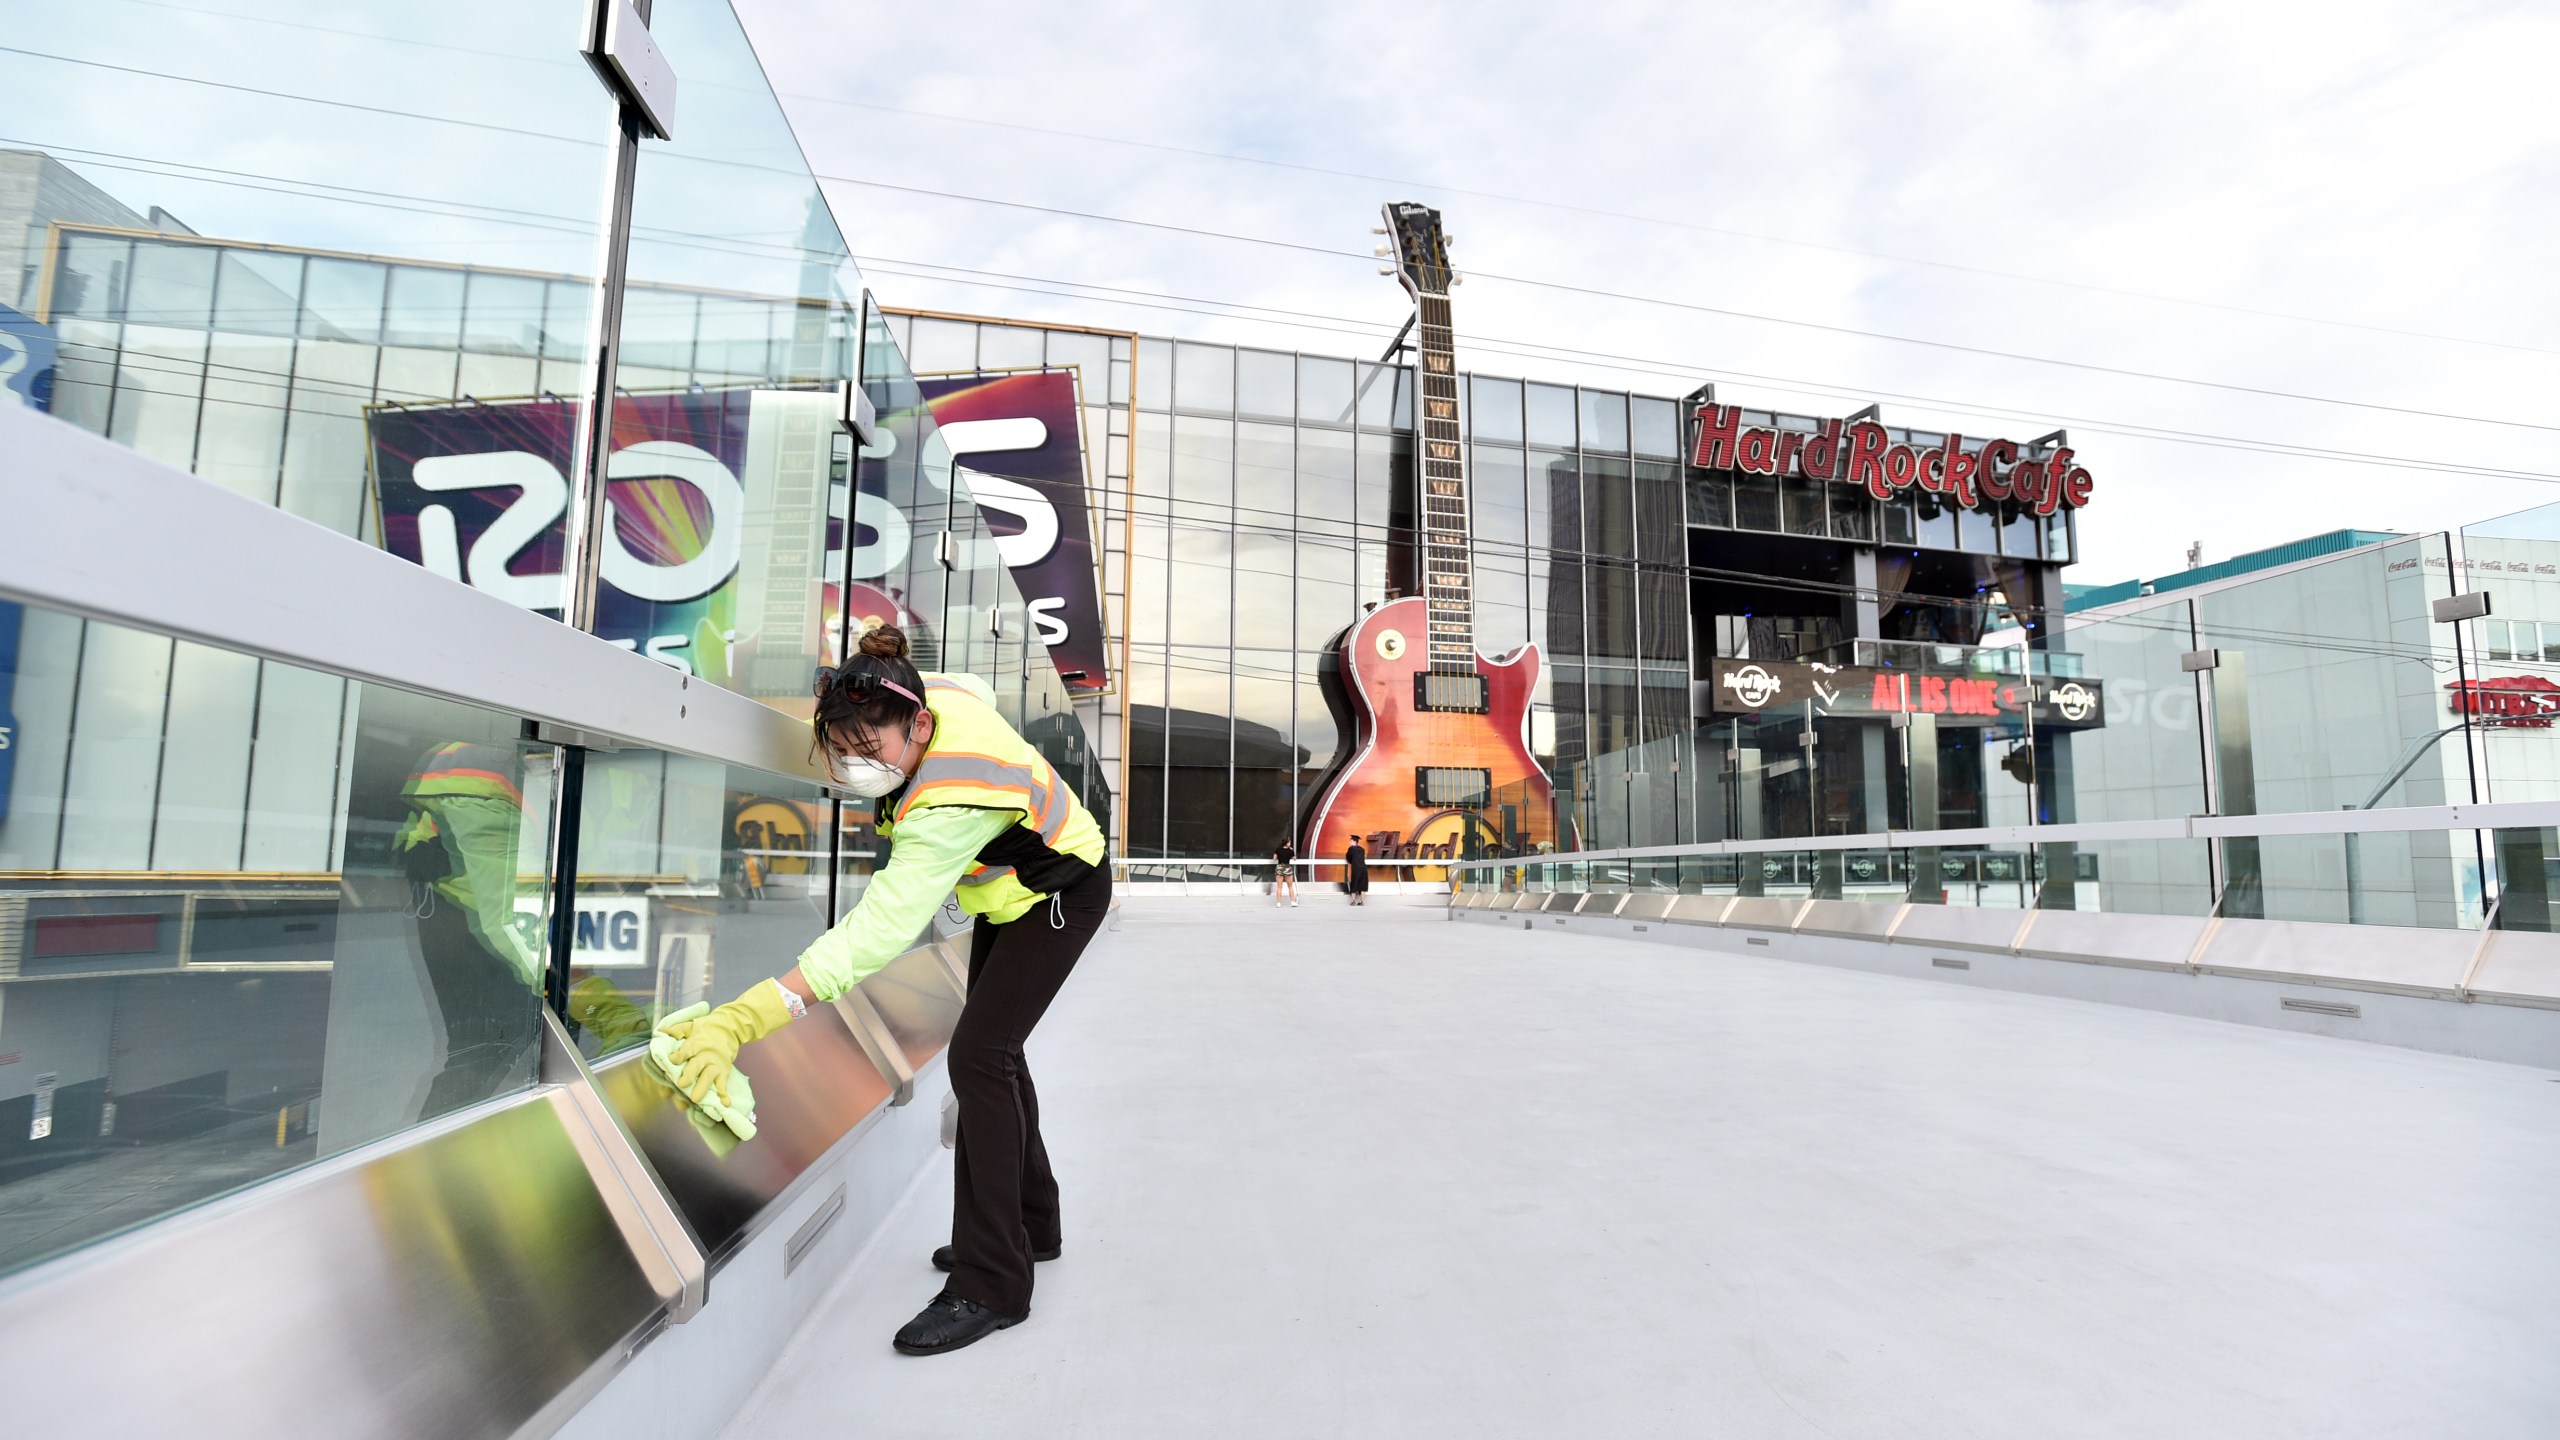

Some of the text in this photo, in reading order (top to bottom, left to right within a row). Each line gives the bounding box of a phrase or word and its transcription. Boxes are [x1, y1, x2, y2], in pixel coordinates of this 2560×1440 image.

[1691, 401, 2094, 517] Hard Rock Cafe
[1724, 673, 1781, 693] Hard Rock
[1872, 673, 1917, 712] ALL
[1920, 676, 1948, 714] IS
[1950, 678, 2000, 717] ONE
[1366, 831, 1459, 867] Hard
